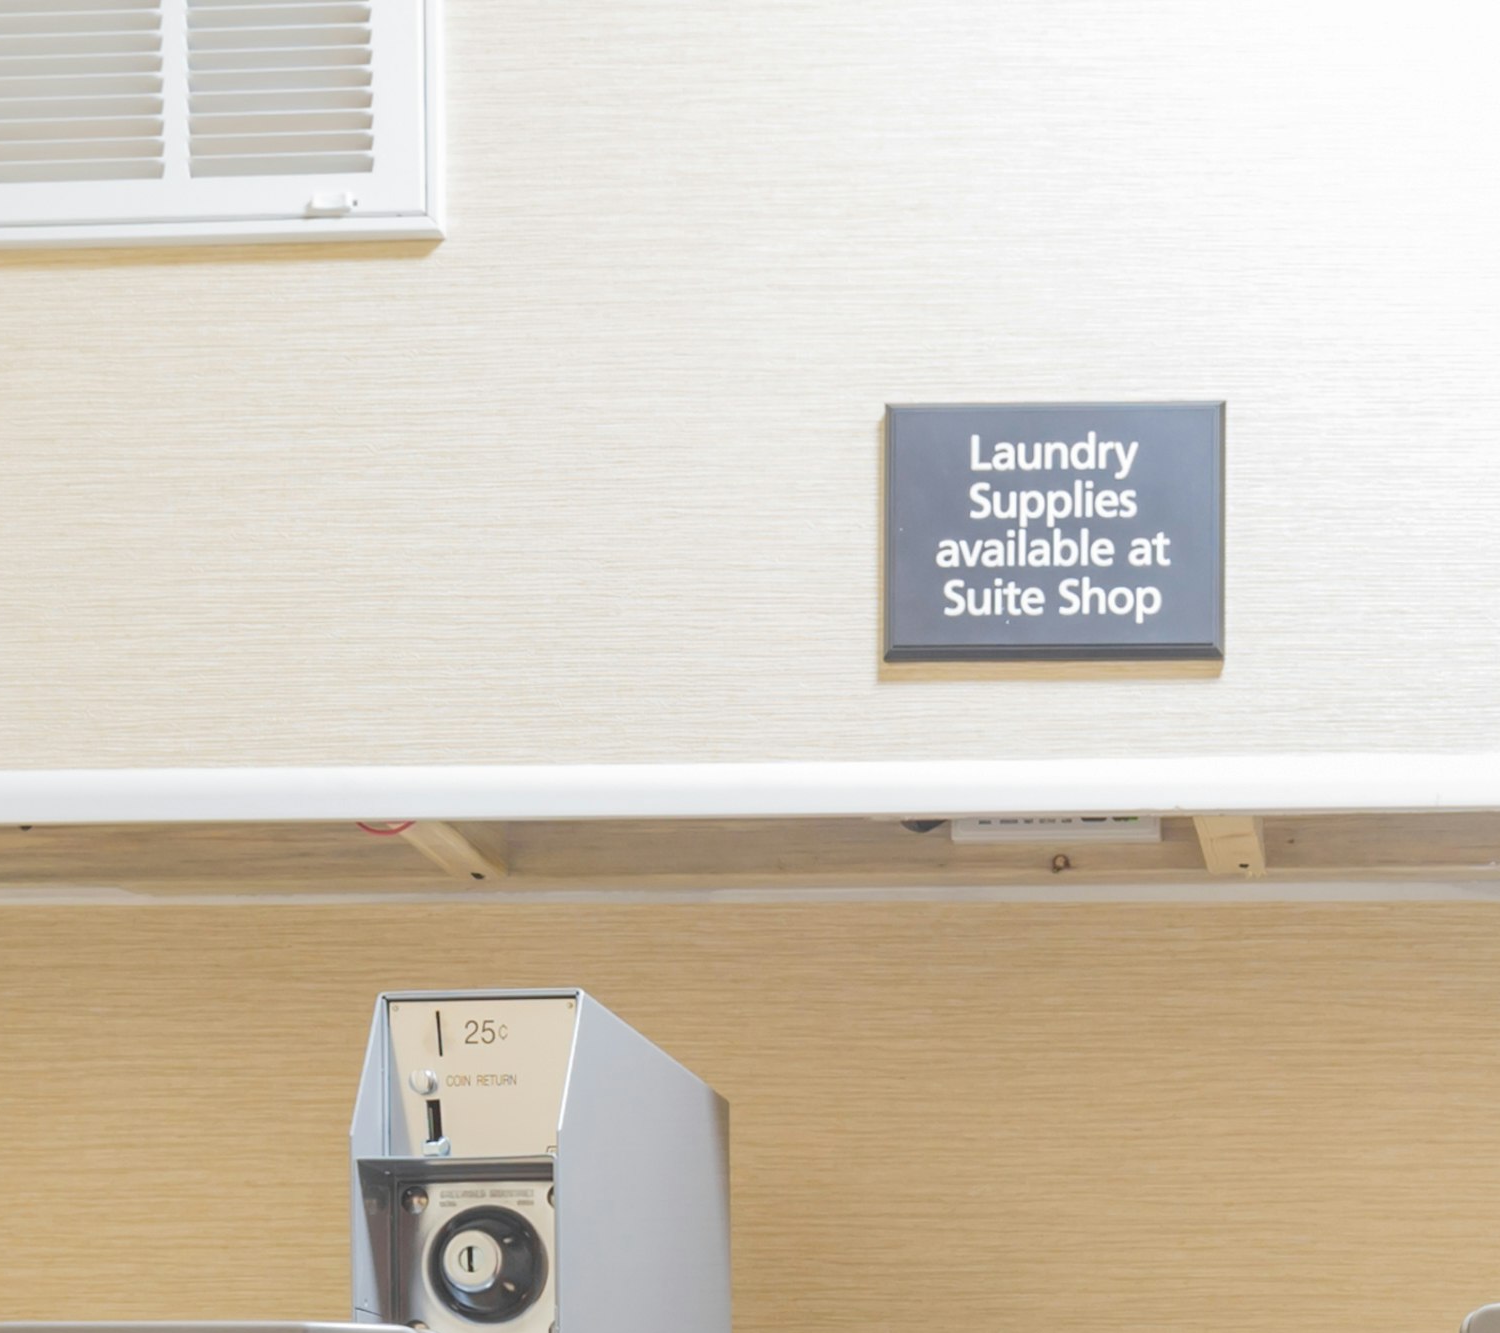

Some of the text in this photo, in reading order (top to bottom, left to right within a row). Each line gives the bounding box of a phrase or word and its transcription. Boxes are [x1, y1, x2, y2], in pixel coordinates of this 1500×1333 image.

[970, 430, 1139, 480] Laundry
[969, 479, 1138, 528] Supplies
[935, 528, 1172, 568] available at
[943, 576, 1162, 624] Suite Shop
[446, 1074, 516, 1087] COIN RETURN
